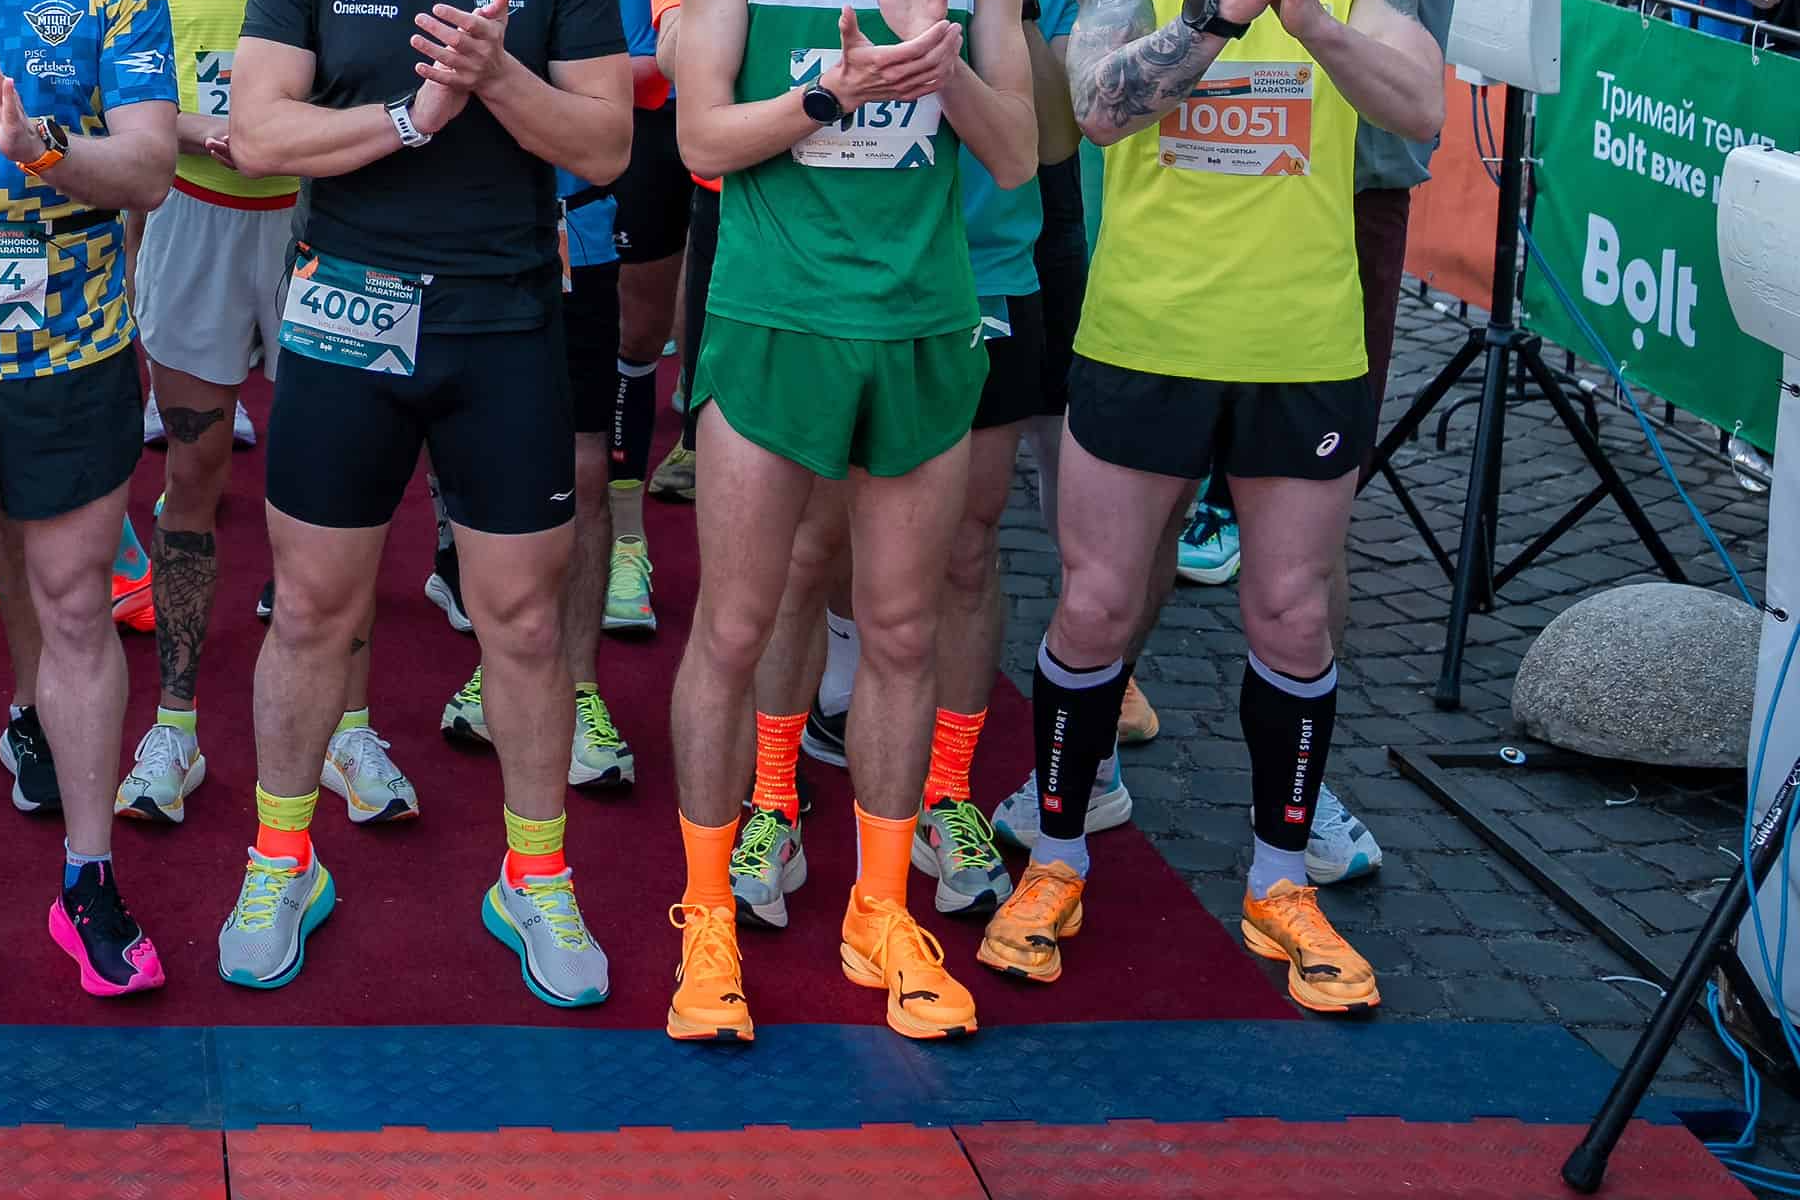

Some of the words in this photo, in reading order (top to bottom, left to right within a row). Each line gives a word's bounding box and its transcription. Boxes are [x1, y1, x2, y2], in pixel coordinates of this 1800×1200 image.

[332, 1, 399, 18] Олександр
[43, 25, 64, 36] 300
[25, 58, 76, 78] Carlsberg
[1253, 86, 1304, 95] MARATHON
[1595, 69, 1697, 142] Тримай
[1177, 102, 1289, 137] 10051
[1593, 119, 1647, 177] Bolt
[1650, 154, 1707, 199] вже
[365, 285, 414, 300] MARATHON
[1581, 211, 1699, 352] Bolt
[300, 285, 395, 331] 4006
[1047, 708, 1069, 793] COMPRESSPORT
[1292, 717, 1313, 803] COMPRESSPORT
